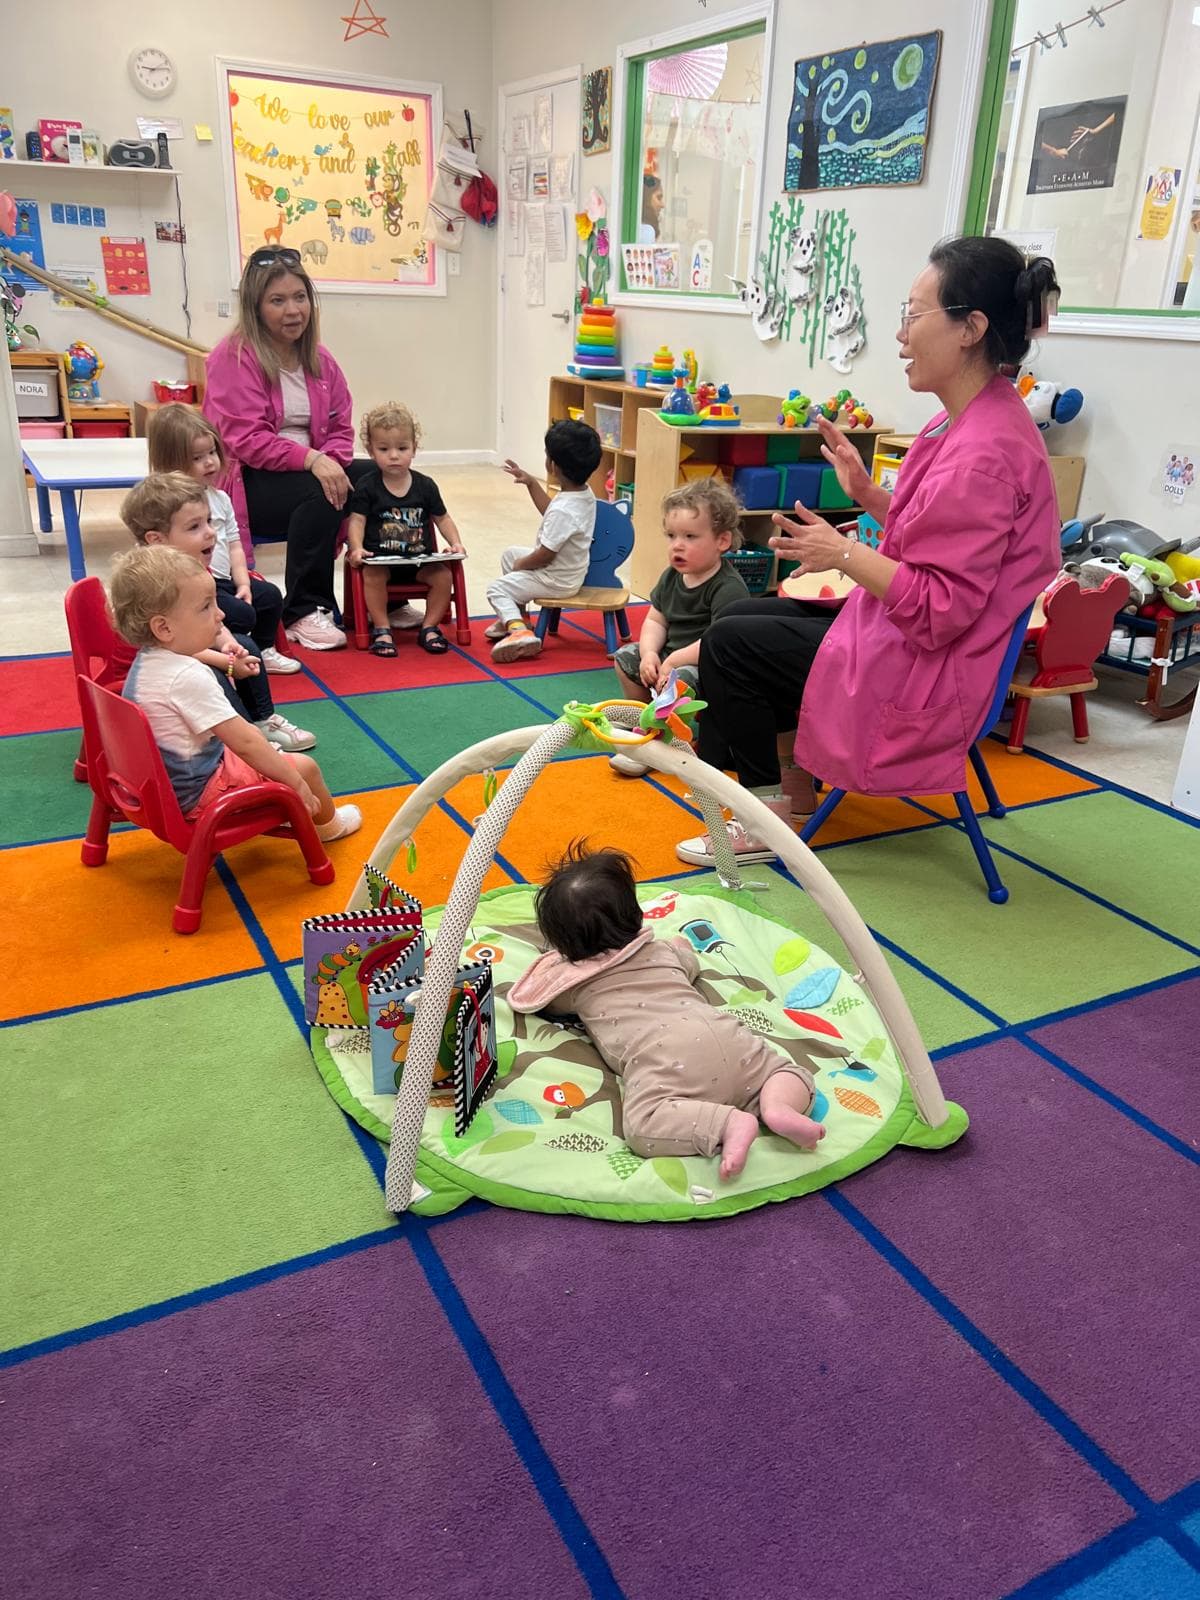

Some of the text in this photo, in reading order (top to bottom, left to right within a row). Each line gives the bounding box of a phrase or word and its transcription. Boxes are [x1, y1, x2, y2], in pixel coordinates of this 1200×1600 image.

[255, 93, 395, 131] We love our
[319, 145, 357, 174] and
[20, 385, 44, 393] NORA
[1164, 485, 1184, 495] DOLLS
